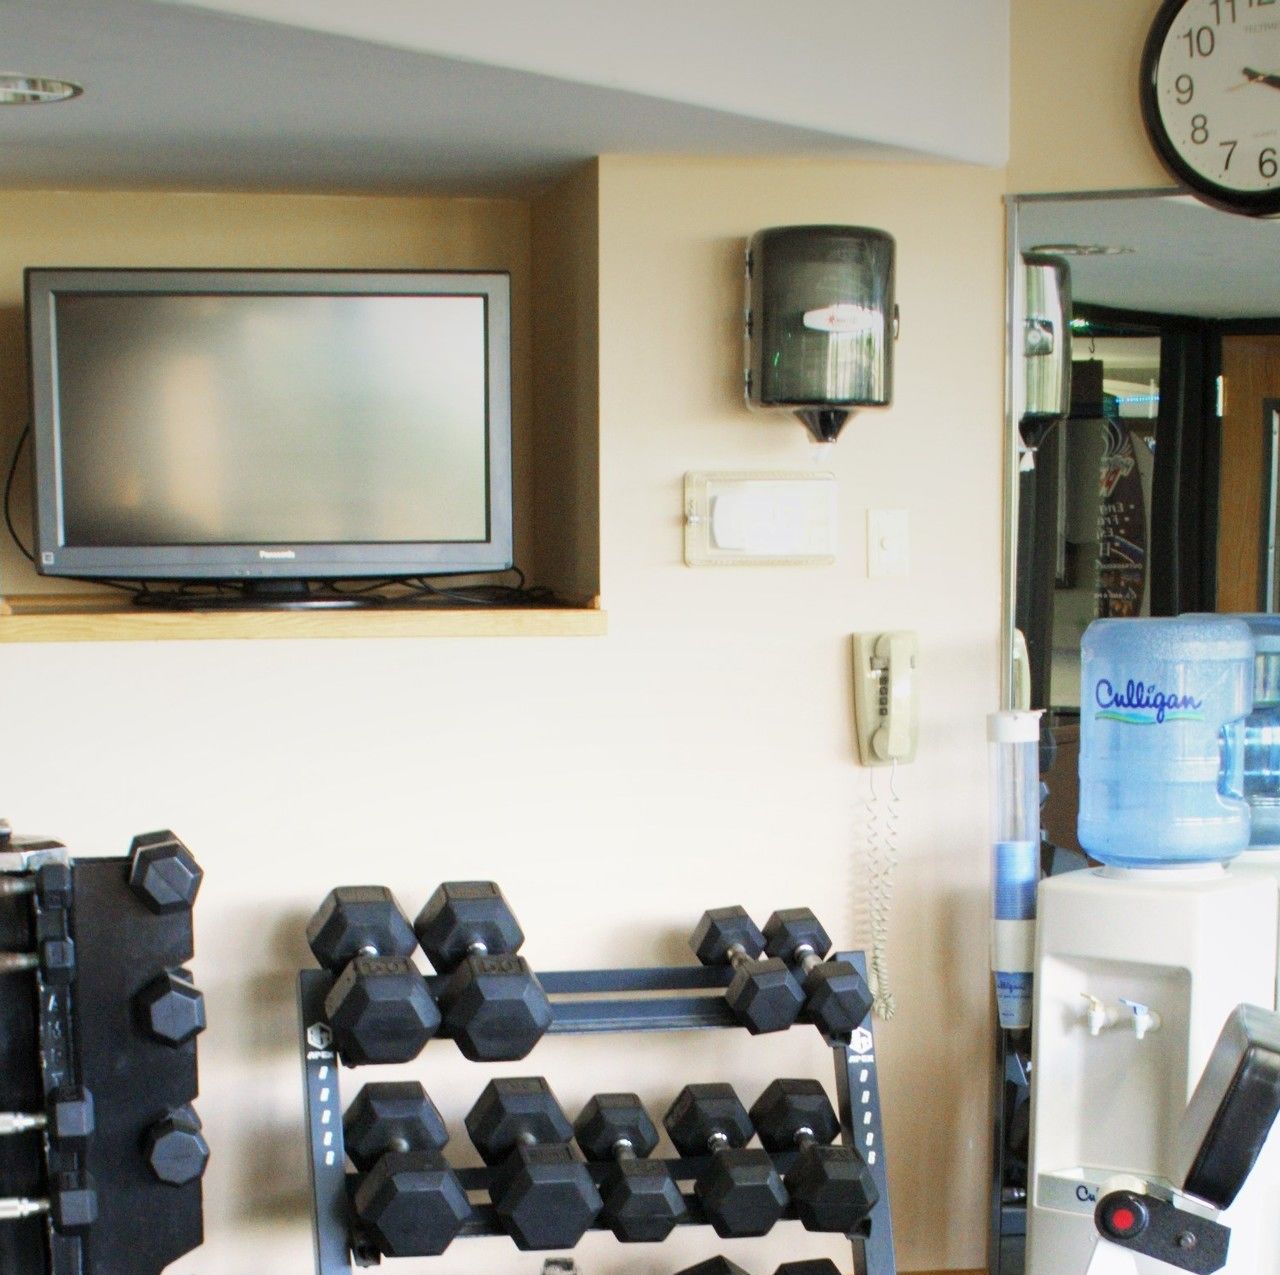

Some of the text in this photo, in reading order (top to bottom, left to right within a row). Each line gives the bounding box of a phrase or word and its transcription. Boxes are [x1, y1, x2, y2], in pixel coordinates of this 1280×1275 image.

[1183, 26, 1215, 58] 10
[1175, 74, 1194, 105] 9
[1191, 114, 1209, 145] 8
[1220, 141, 1237, 171] 7
[1258, 148, 1277, 178] 6
[1095, 679, 1202, 724] Culligan
